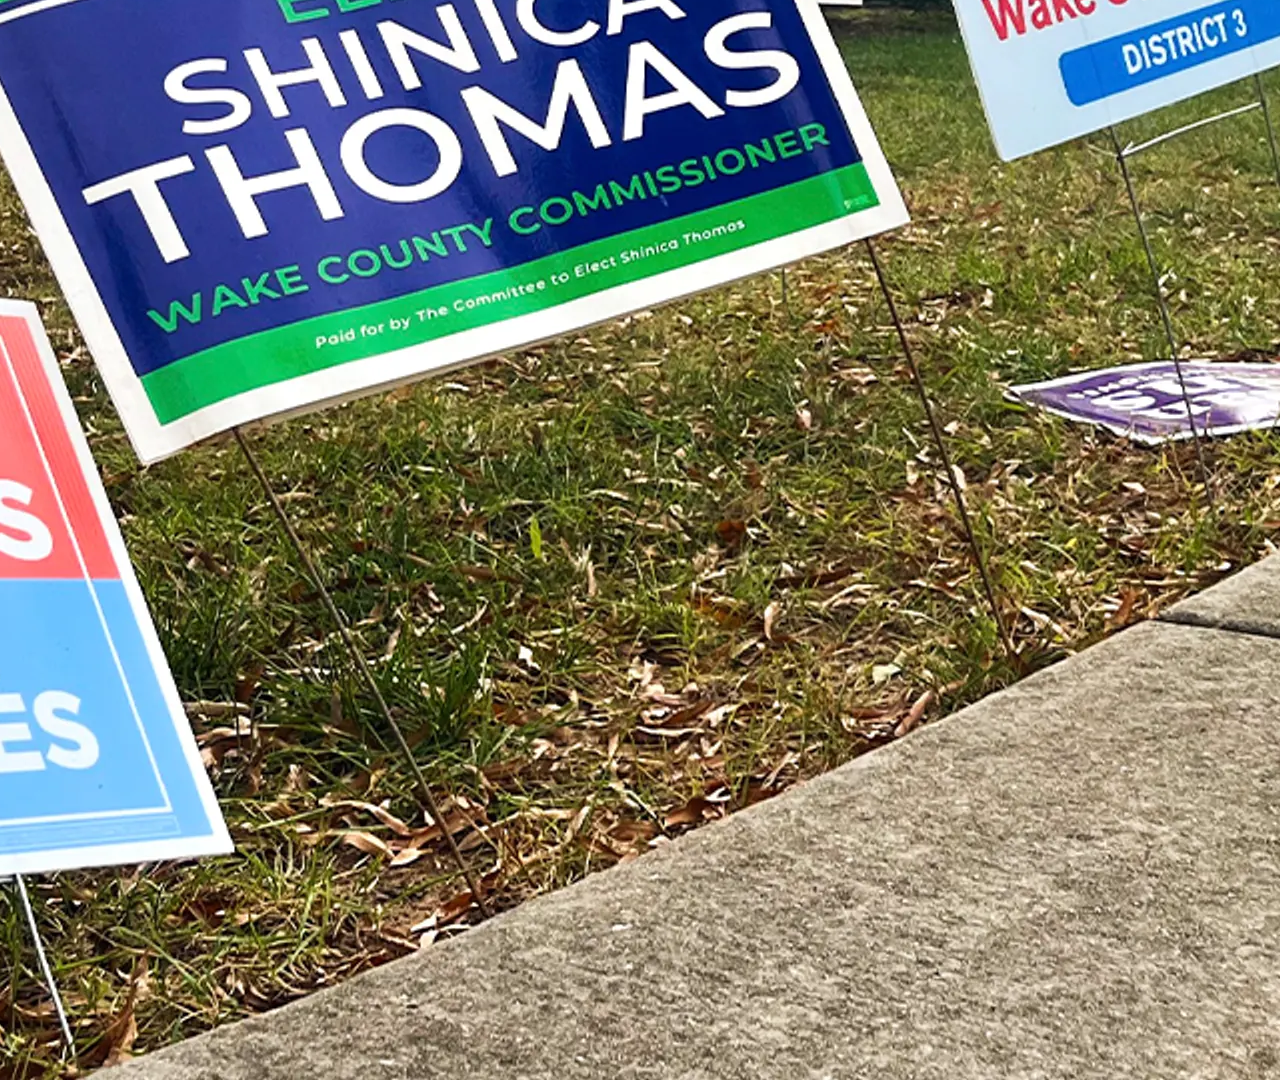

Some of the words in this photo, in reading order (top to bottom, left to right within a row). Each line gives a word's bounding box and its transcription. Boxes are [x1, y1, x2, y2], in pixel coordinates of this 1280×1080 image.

[1122, 13, 1228, 75] DISTRICT
[1231, 8, 1248, 37] 3
[82, 11, 802, 265] THOMAS
[147, 264, 309, 333] WAKE
[316, 218, 495, 284] COUNTY
[509, 123, 831, 236] COMMISSIONER
[315, 326, 356, 349] Paid
[360, 320, 386, 338] for
[389, 314, 411, 333] by
[415, 303, 448, 323] The
[453, 278, 547, 310] Committee
[550, 270, 570, 285] to
[574, 257, 617, 279] Elect
[620, 238, 679, 264] Shinica
[682, 219, 746, 247] Thomas
